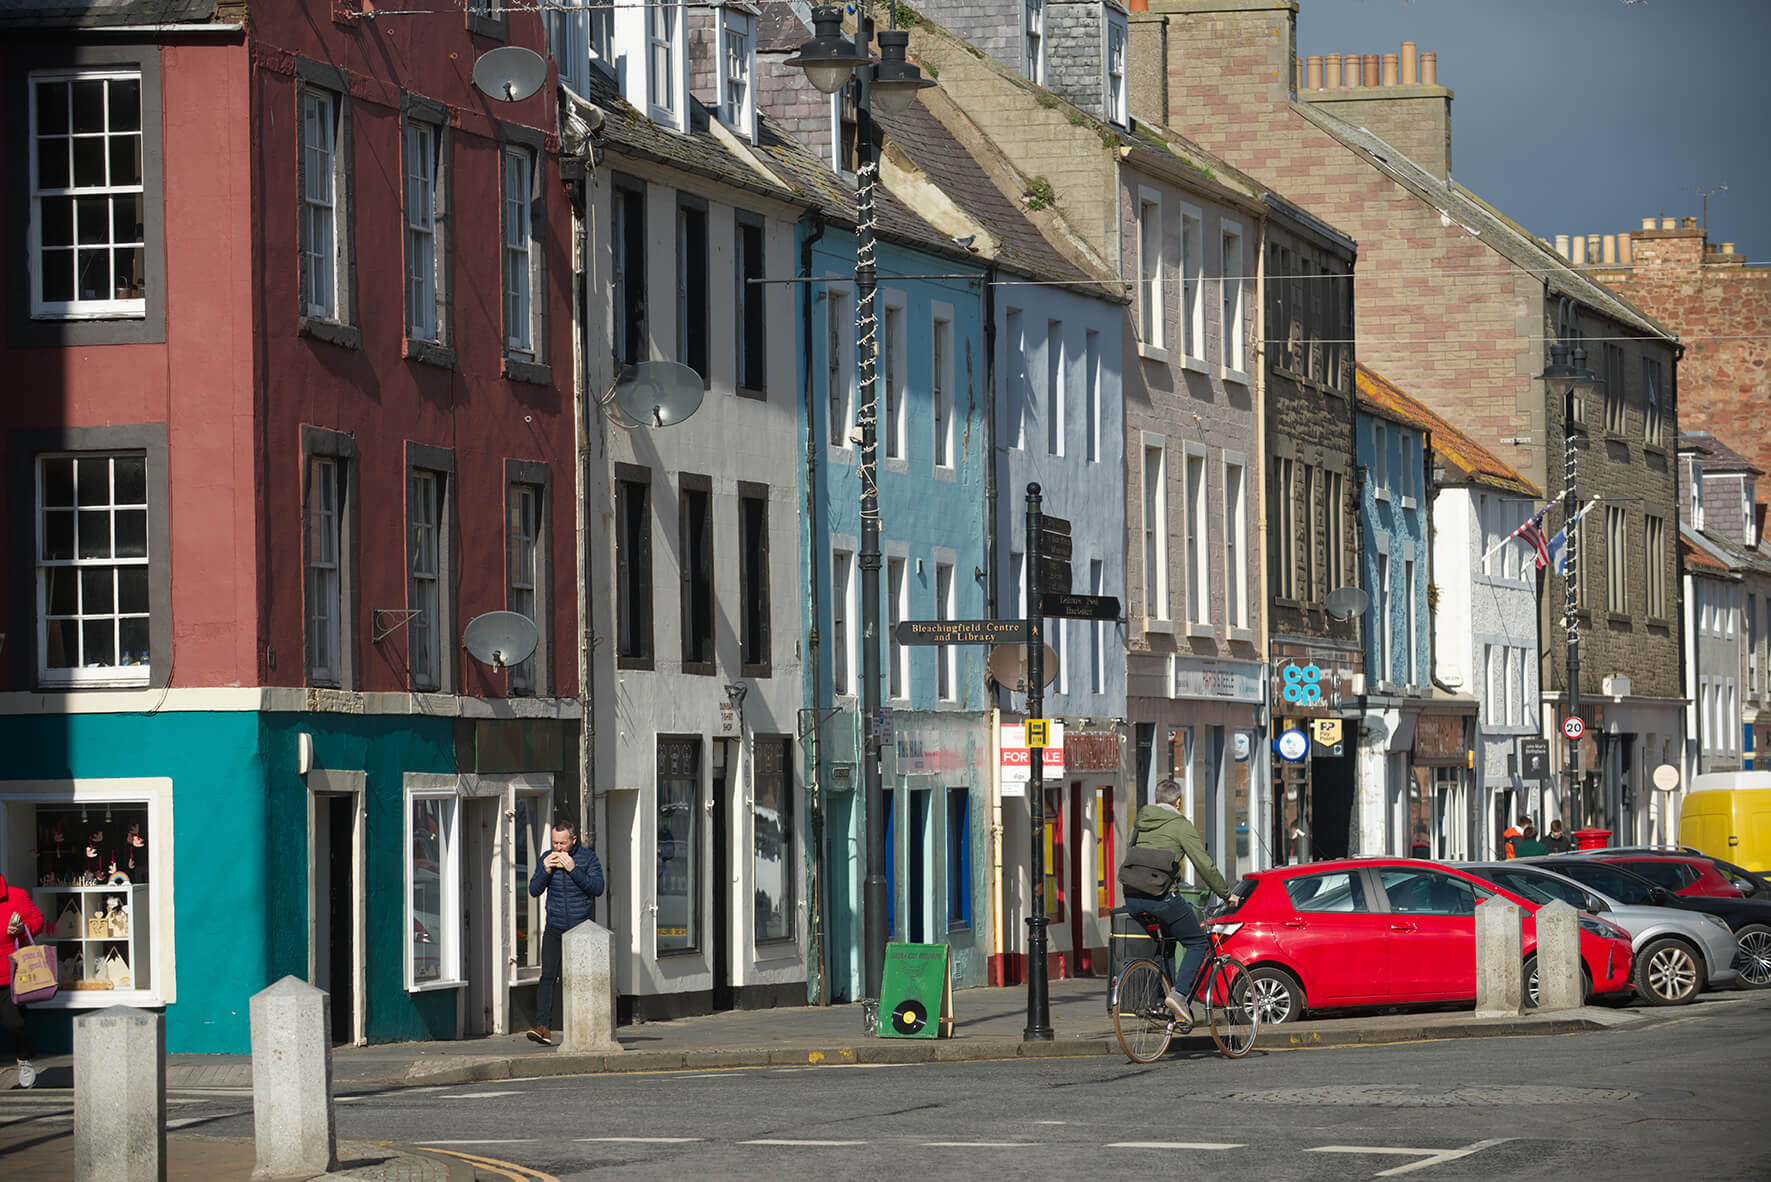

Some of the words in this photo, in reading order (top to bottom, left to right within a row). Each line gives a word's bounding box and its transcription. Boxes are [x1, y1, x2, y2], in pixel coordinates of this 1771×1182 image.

[912, 623, 981, 633] Bleachingfield
[986, 622, 1020, 632] Centre
[934, 632, 951, 641] and
[957, 632, 997, 643] Library
[1566, 723, 1582, 732] 20
[1003, 751, 1029, 762] FOR
